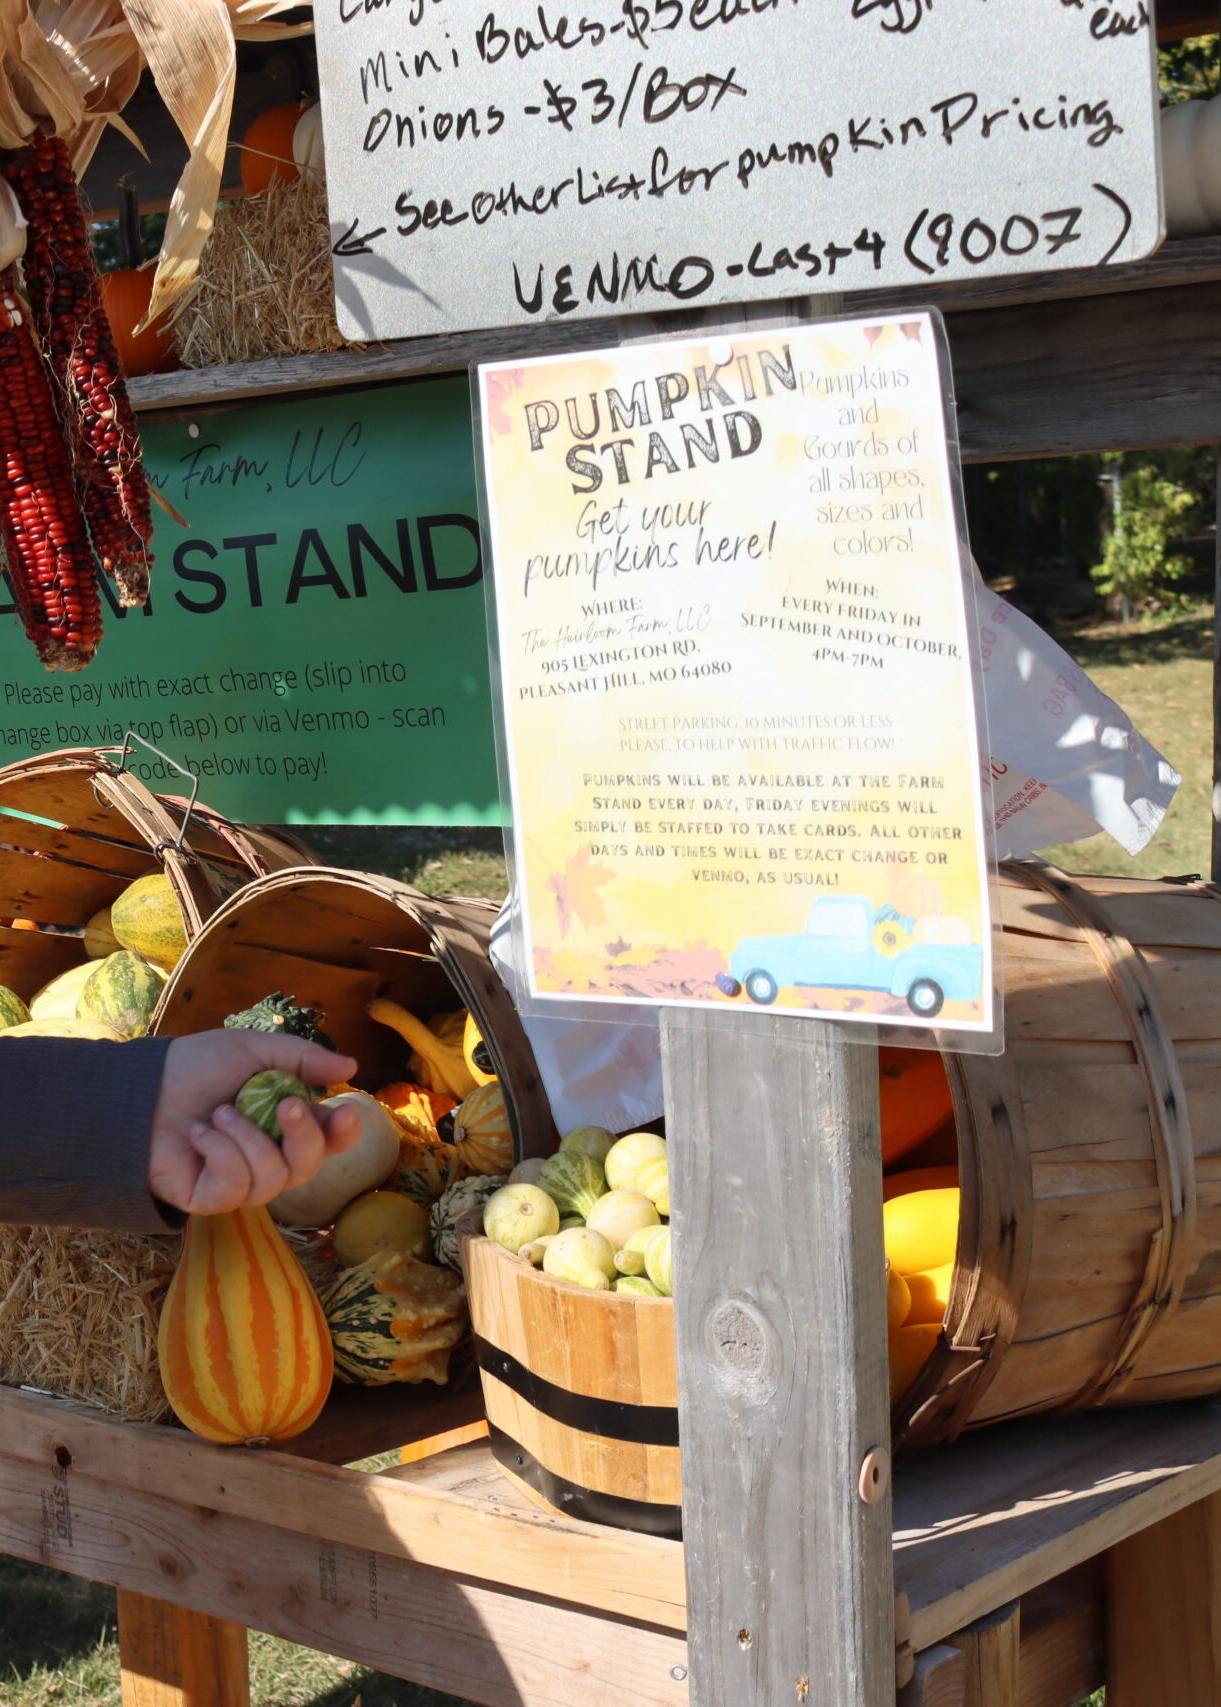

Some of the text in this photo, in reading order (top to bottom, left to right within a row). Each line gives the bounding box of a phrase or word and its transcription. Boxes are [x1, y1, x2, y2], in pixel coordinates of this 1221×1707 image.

[363, 105, 506, 152] Onions
[394, 188, 469, 236] See
[650, 146, 730, 198] for
[929, 91, 1124, 148] Pricing
[902, 184, 1133, 276] (9007)
[523, 343, 798, 452] PUMPKIN
[799, 366, 910, 399] Pumpkins
[838, 397, 880, 427] and
[180, 420, 369, 501] Farm, LLC
[565, 409, 764, 496] STAND
[803, 427, 920, 461] Gourds of
[808, 467, 831, 493] all
[576, 497, 713, 547] Get your
[816, 493, 924, 525] sizes and
[833, 527, 914, 556] colors!
[172, 512, 484, 614] STAND
[523, 519, 778, 599] pumpkins here!
[740, 611, 833, 638] SEPTEMBER
[835, 626, 874, 645] AND
[781, 595, 922, 628] EVERY FRIDAY IN
[521, 628, 549, 656] The
[553, 620, 622, 652] Heirloom
[675, 602, 713, 634] LLC
[541, 659, 569, 675] 905
[572, 642, 669, 673] LEXINGTON
[811, 646, 885, 670] 4PM-7PM
[4, 659, 407, 709] Please pay with exact change (slip into
[518, 678, 600, 701] PLEASANT
[648, 666, 678, 684] MO
[680, 660, 733, 679] 64080
[55, 720, 94, 744] box
[95, 718, 124, 741] via
[128, 718, 165, 745] top
[169, 712, 219, 742] flap)
[225, 715, 247, 734] or
[252, 709, 282, 733] via
[284, 708, 370, 732] Venmo
[392, 706, 447, 728] scan
[618, 716, 669, 733] STREET
[763, 714, 830, 730] MINUTES
[833, 714, 857, 729] OR
[861, 713, 894, 729] LESS
[675, 737, 697, 752] TO
[699, 737, 736, 752] HELP
[738, 736, 778, 752] WITH
[782, 736, 844, 752] TRAFFIC
[847, 736, 897, 752] FLOW!
[130, 751, 329, 782] code below to pay!
[582, 773, 946, 790] PUMPKINS WILL BE AVAILABLE AT THE FARM
[592, 796, 642, 811] STAND
[648, 797, 696, 812] EVERY
[745, 797, 804, 813] FRIDAY
[811, 799, 891, 815] EVENINGS
[897, 800, 940, 816] WILL
[573, 820, 628, 836] SIMPLY
[634, 821, 653, 835] BE
[658, 821, 724, 836] STAFFED
[729, 822, 751, 836] TO
[757, 822, 798, 838] TAKE
[869, 824, 903, 840] ALL
[907, 825, 963, 842] OTHER
[590, 844, 950, 866] DAYS AND TIMES WILL BE EXACT CHANGE OR
[756, 871, 778, 886] AS
[782, 871, 841, 888] USUAL!
